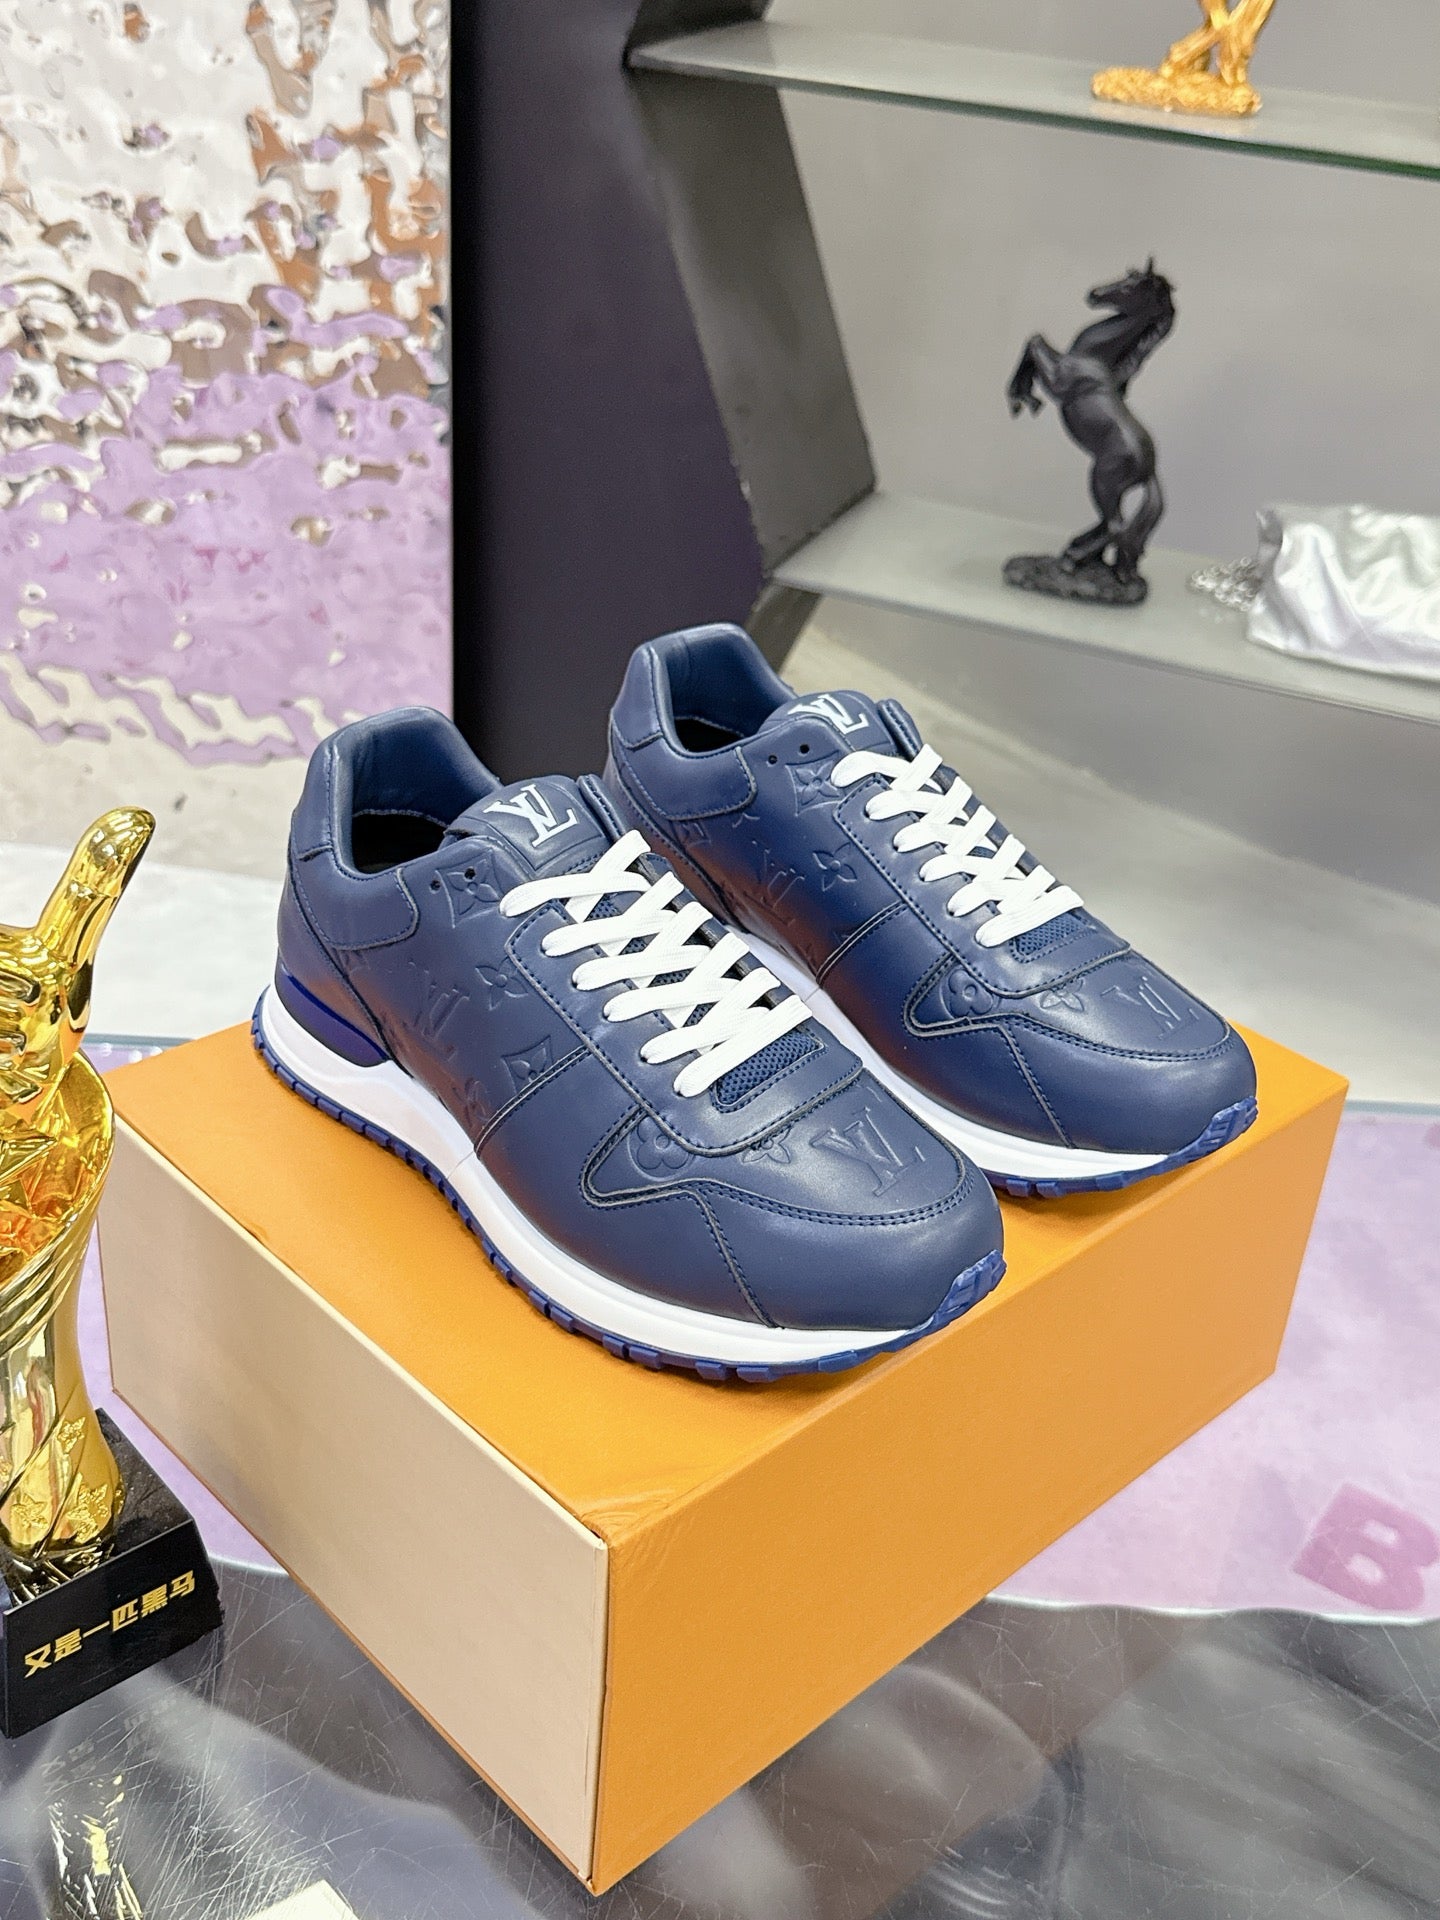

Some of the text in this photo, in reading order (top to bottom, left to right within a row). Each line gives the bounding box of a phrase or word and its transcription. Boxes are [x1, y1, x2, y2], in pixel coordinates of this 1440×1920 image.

[787, 693, 869, 735] LV
[483, 783, 579, 848] LV
[1292, 1481, 1440, 1613] B
[24, 1570, 195, 1678] 又是一匹黑马
